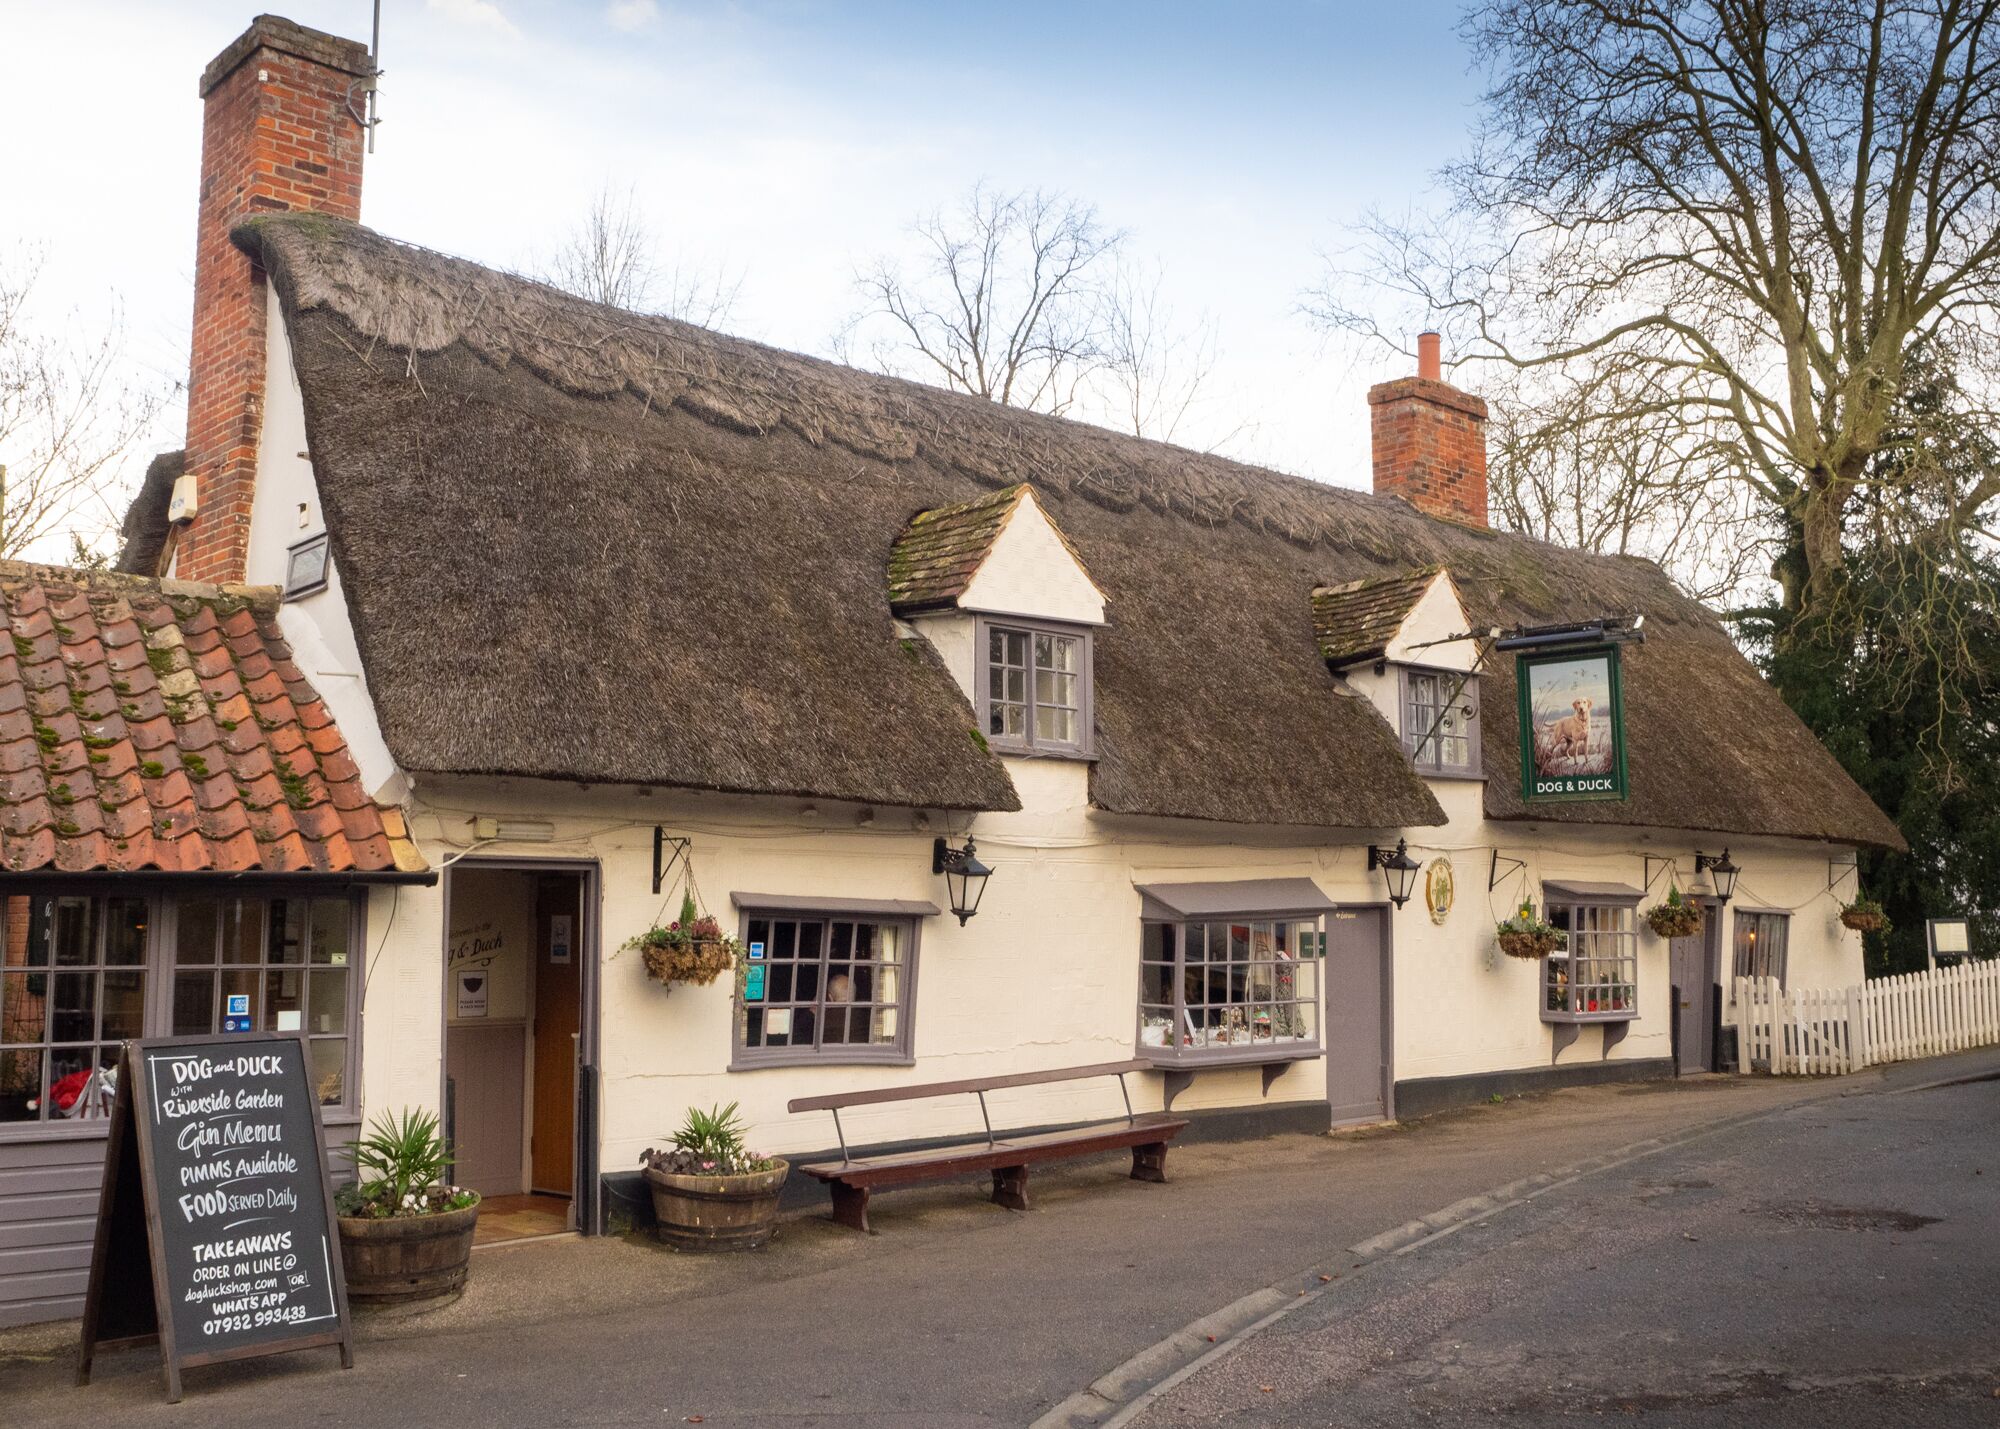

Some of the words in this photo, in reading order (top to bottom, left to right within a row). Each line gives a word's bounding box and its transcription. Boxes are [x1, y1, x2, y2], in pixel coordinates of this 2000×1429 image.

[1537, 781, 1563, 793] DOG
[1566, 781, 1575, 793] &
[1578, 779, 1613, 792] DUCK
[172, 1059, 213, 1083] DOG
[213, 1060, 235, 1073] and
[237, 1056, 283, 1077] DUCK
[163, 1089, 231, 1118] Riverside
[235, 1088, 283, 1110] Garden
[171, 1085, 193, 1097] WITH
[177, 1121, 219, 1158] Gin
[223, 1121, 281, 1146] Menu
[180, 1160, 232, 1187] PIMMS
[235, 1151, 298, 1177] Available
[179, 1190, 228, 1223] FOOD
[228, 1193, 264, 1212] SERVED
[267, 1187, 297, 1213] Daily
[193, 1231, 292, 1263] TAKEAWAYS
[193, 1265, 230, 1282] ORDER
[234, 1262, 250, 1276] ON
[185, 1278, 277, 1303] dogduckshop.com
[291, 1275, 305, 1285] OR
[261, 1293, 287, 1308] APP
[203, 1313, 252, 1335] 07932
[255, 1305, 306, 1327] 993433
